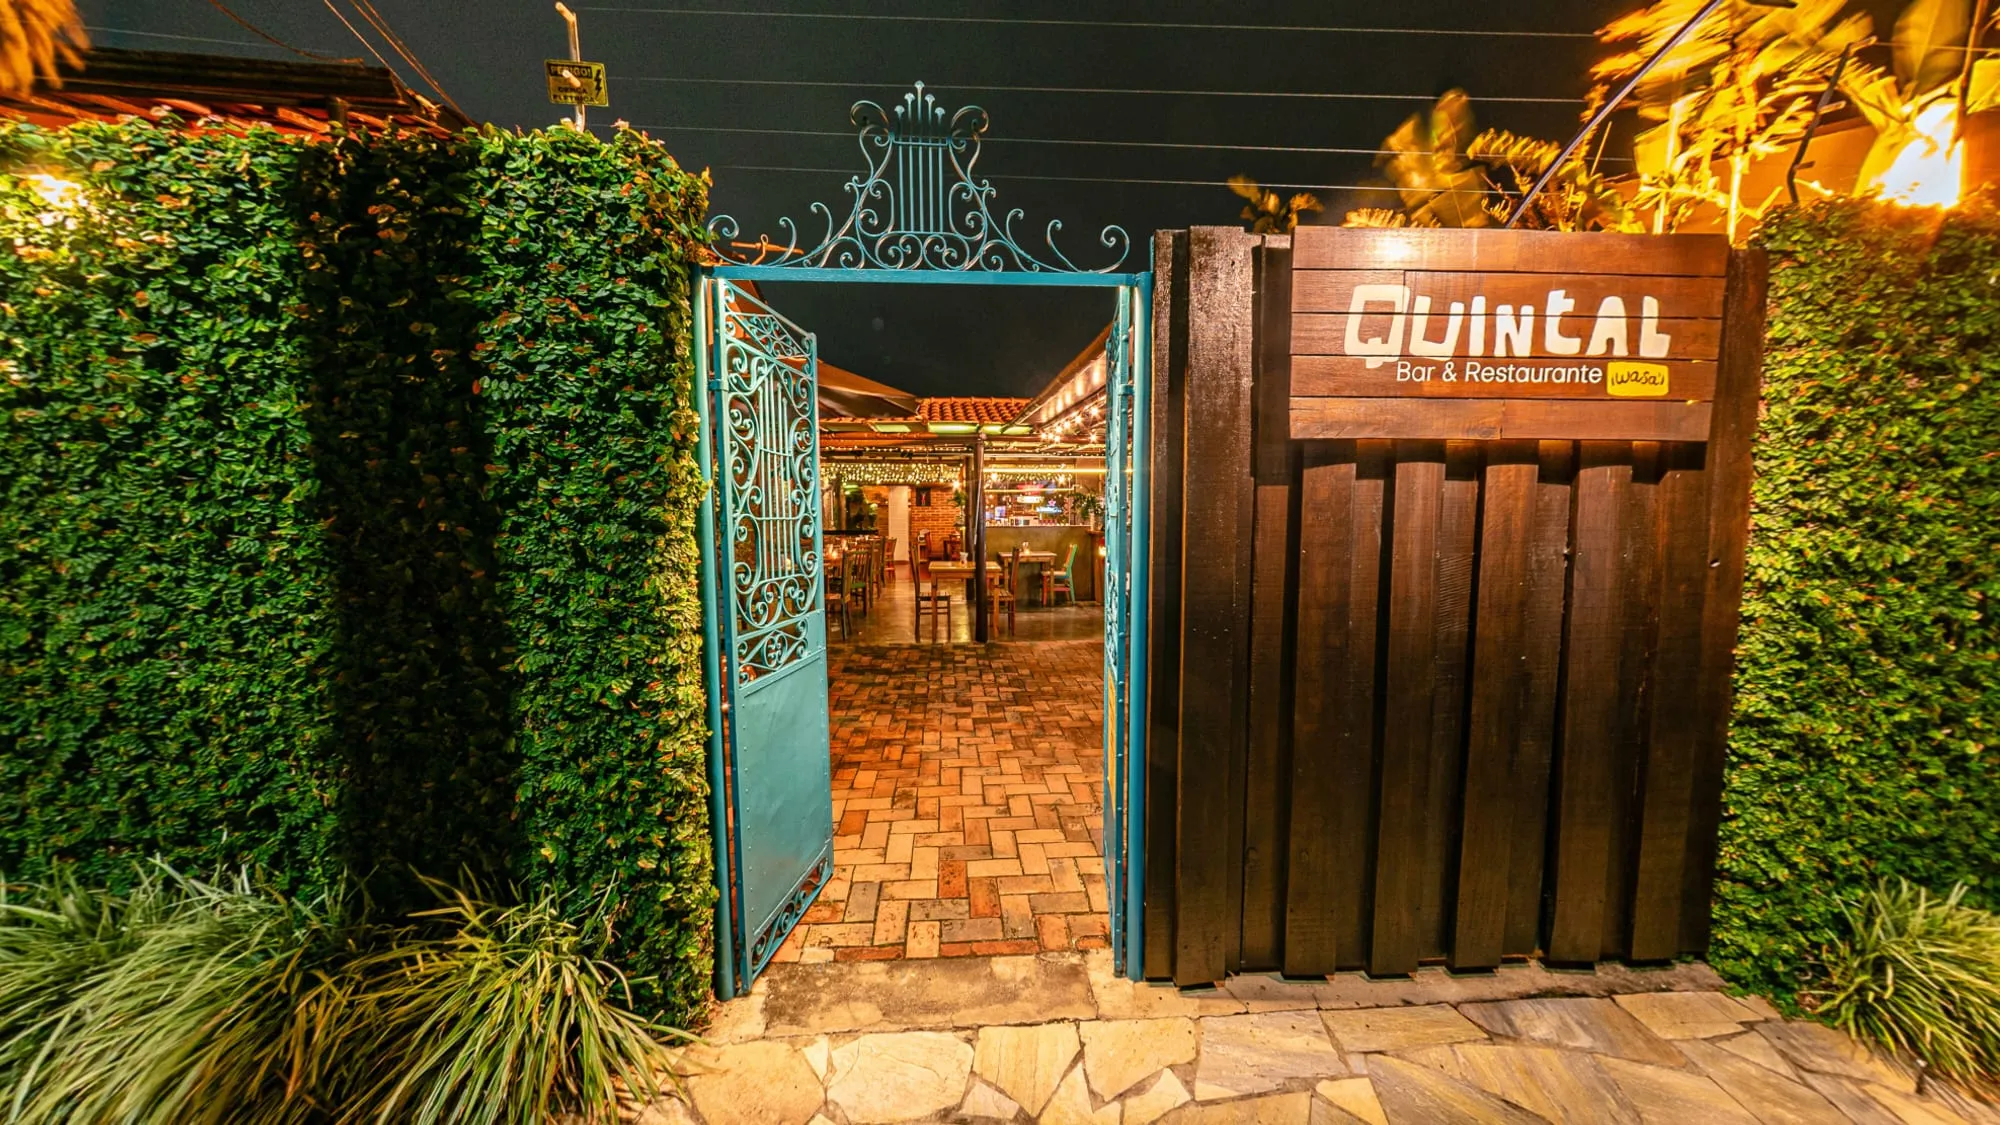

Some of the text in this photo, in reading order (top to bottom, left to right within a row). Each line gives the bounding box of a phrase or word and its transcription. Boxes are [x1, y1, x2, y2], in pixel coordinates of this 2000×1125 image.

[1396, 361, 1603, 384] Bar & Restaurante
